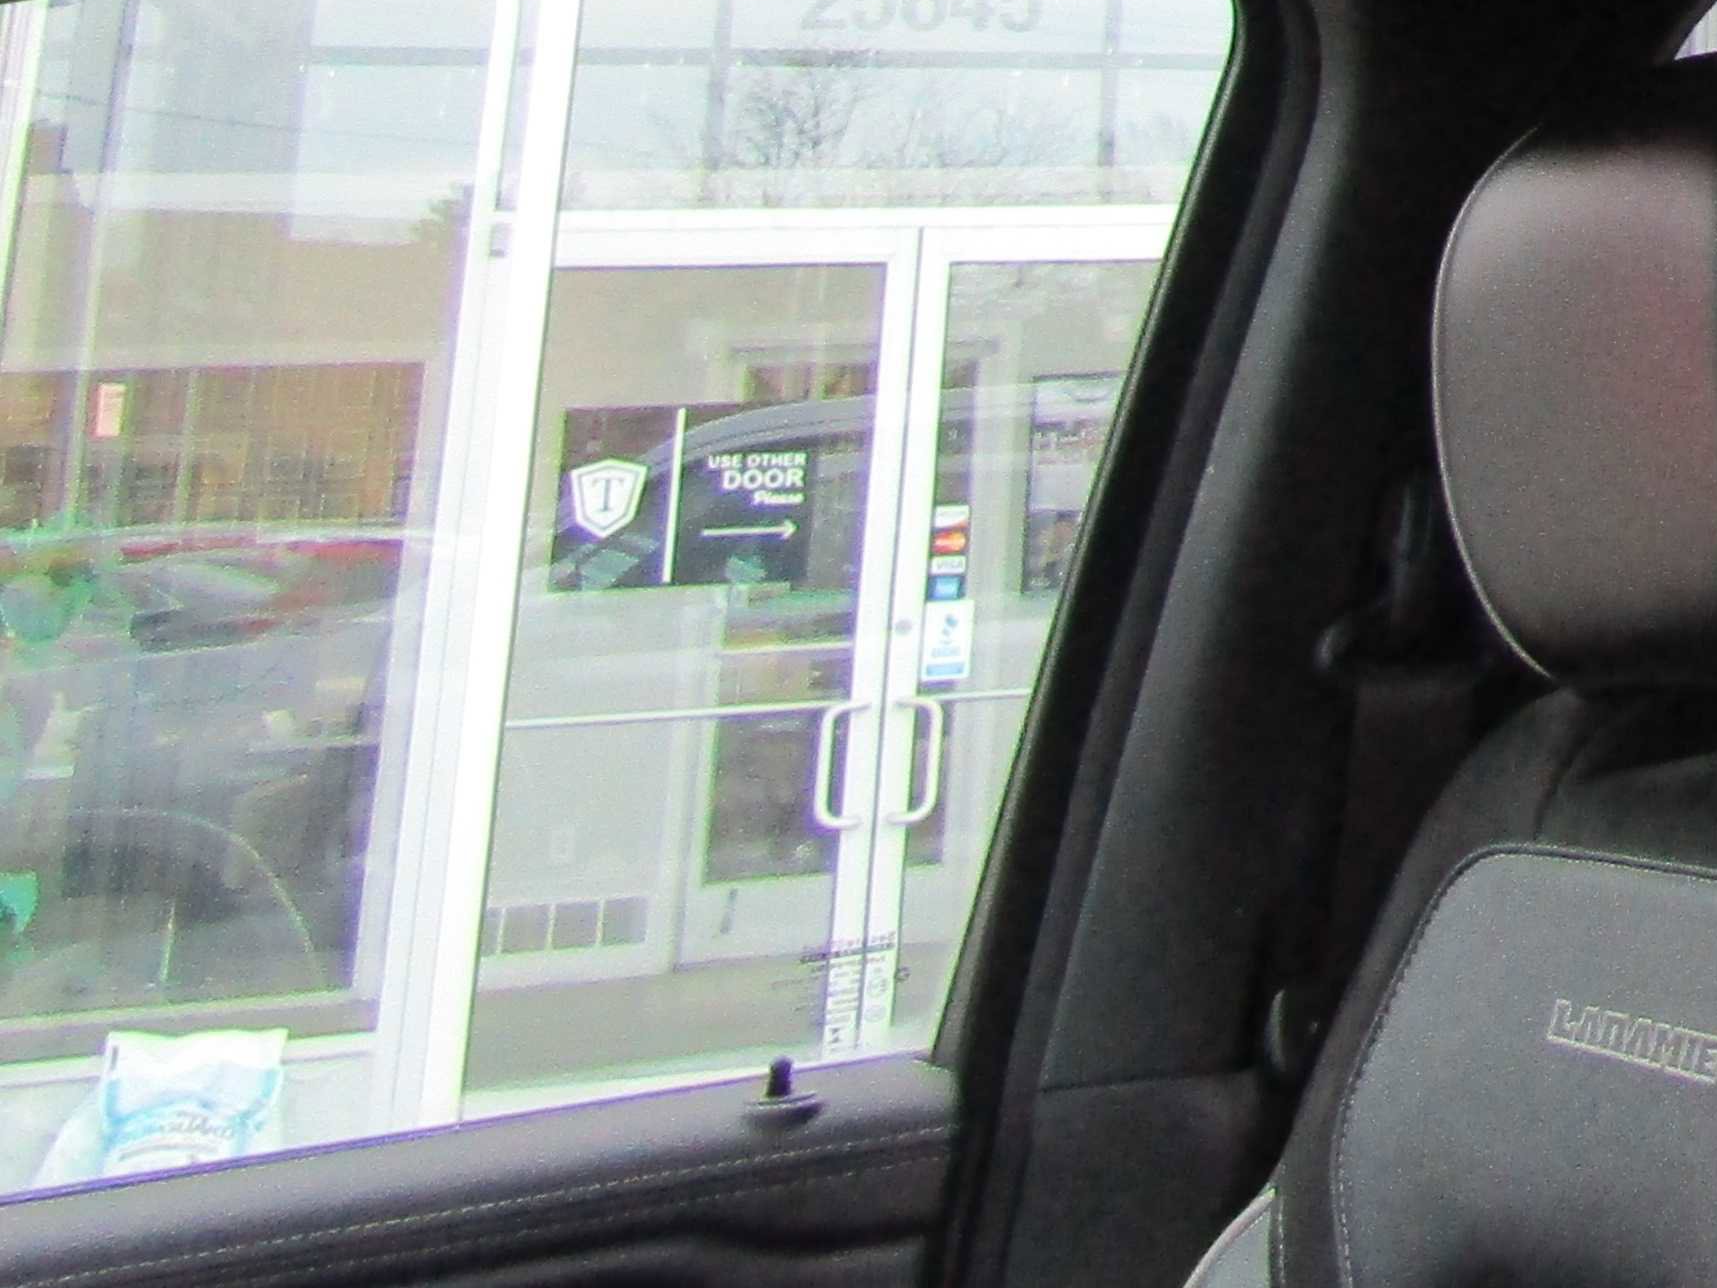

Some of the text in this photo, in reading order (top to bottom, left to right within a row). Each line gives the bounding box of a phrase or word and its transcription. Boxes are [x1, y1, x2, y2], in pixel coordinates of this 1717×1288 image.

[707, 452, 807, 469] USE OTHER
[722, 468, 805, 490] DOOR
